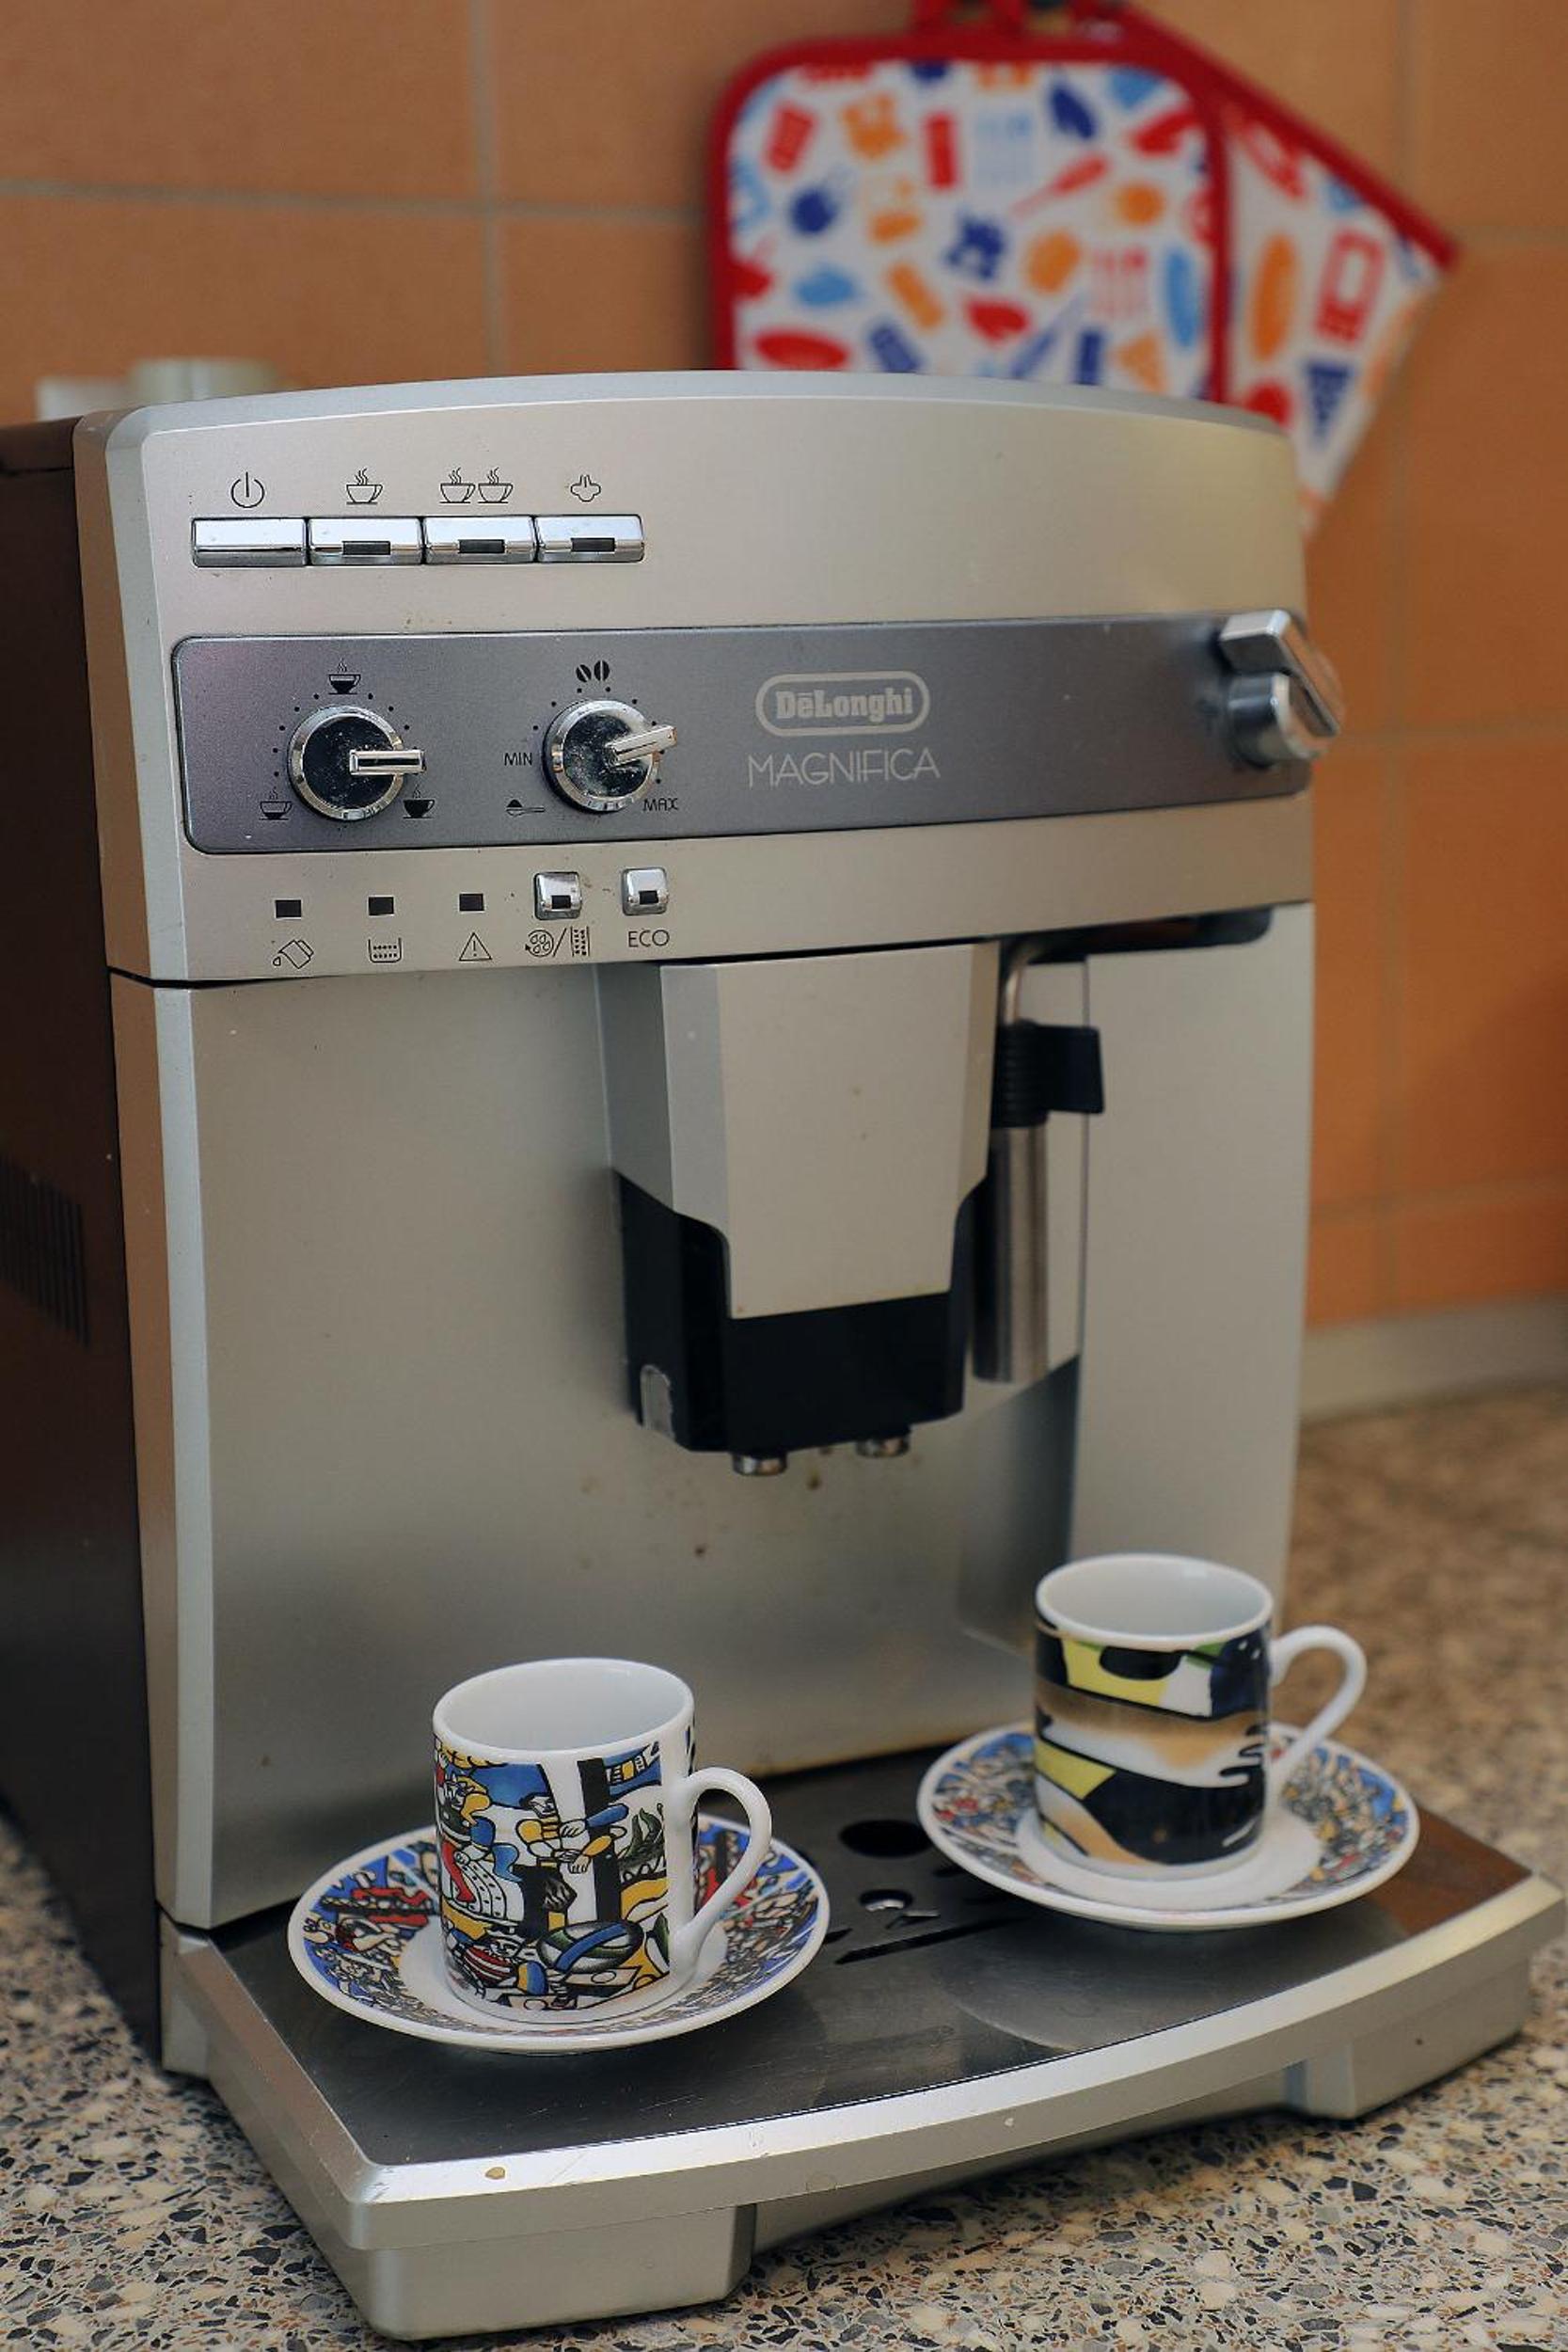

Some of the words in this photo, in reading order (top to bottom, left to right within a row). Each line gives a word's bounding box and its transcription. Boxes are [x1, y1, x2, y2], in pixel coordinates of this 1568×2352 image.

[503, 752, 532, 766] MIN
[748, 746, 941, 790] MAGNIFICA
[642, 797, 678, 812] MAX
[627, 929, 670, 947] ECO
